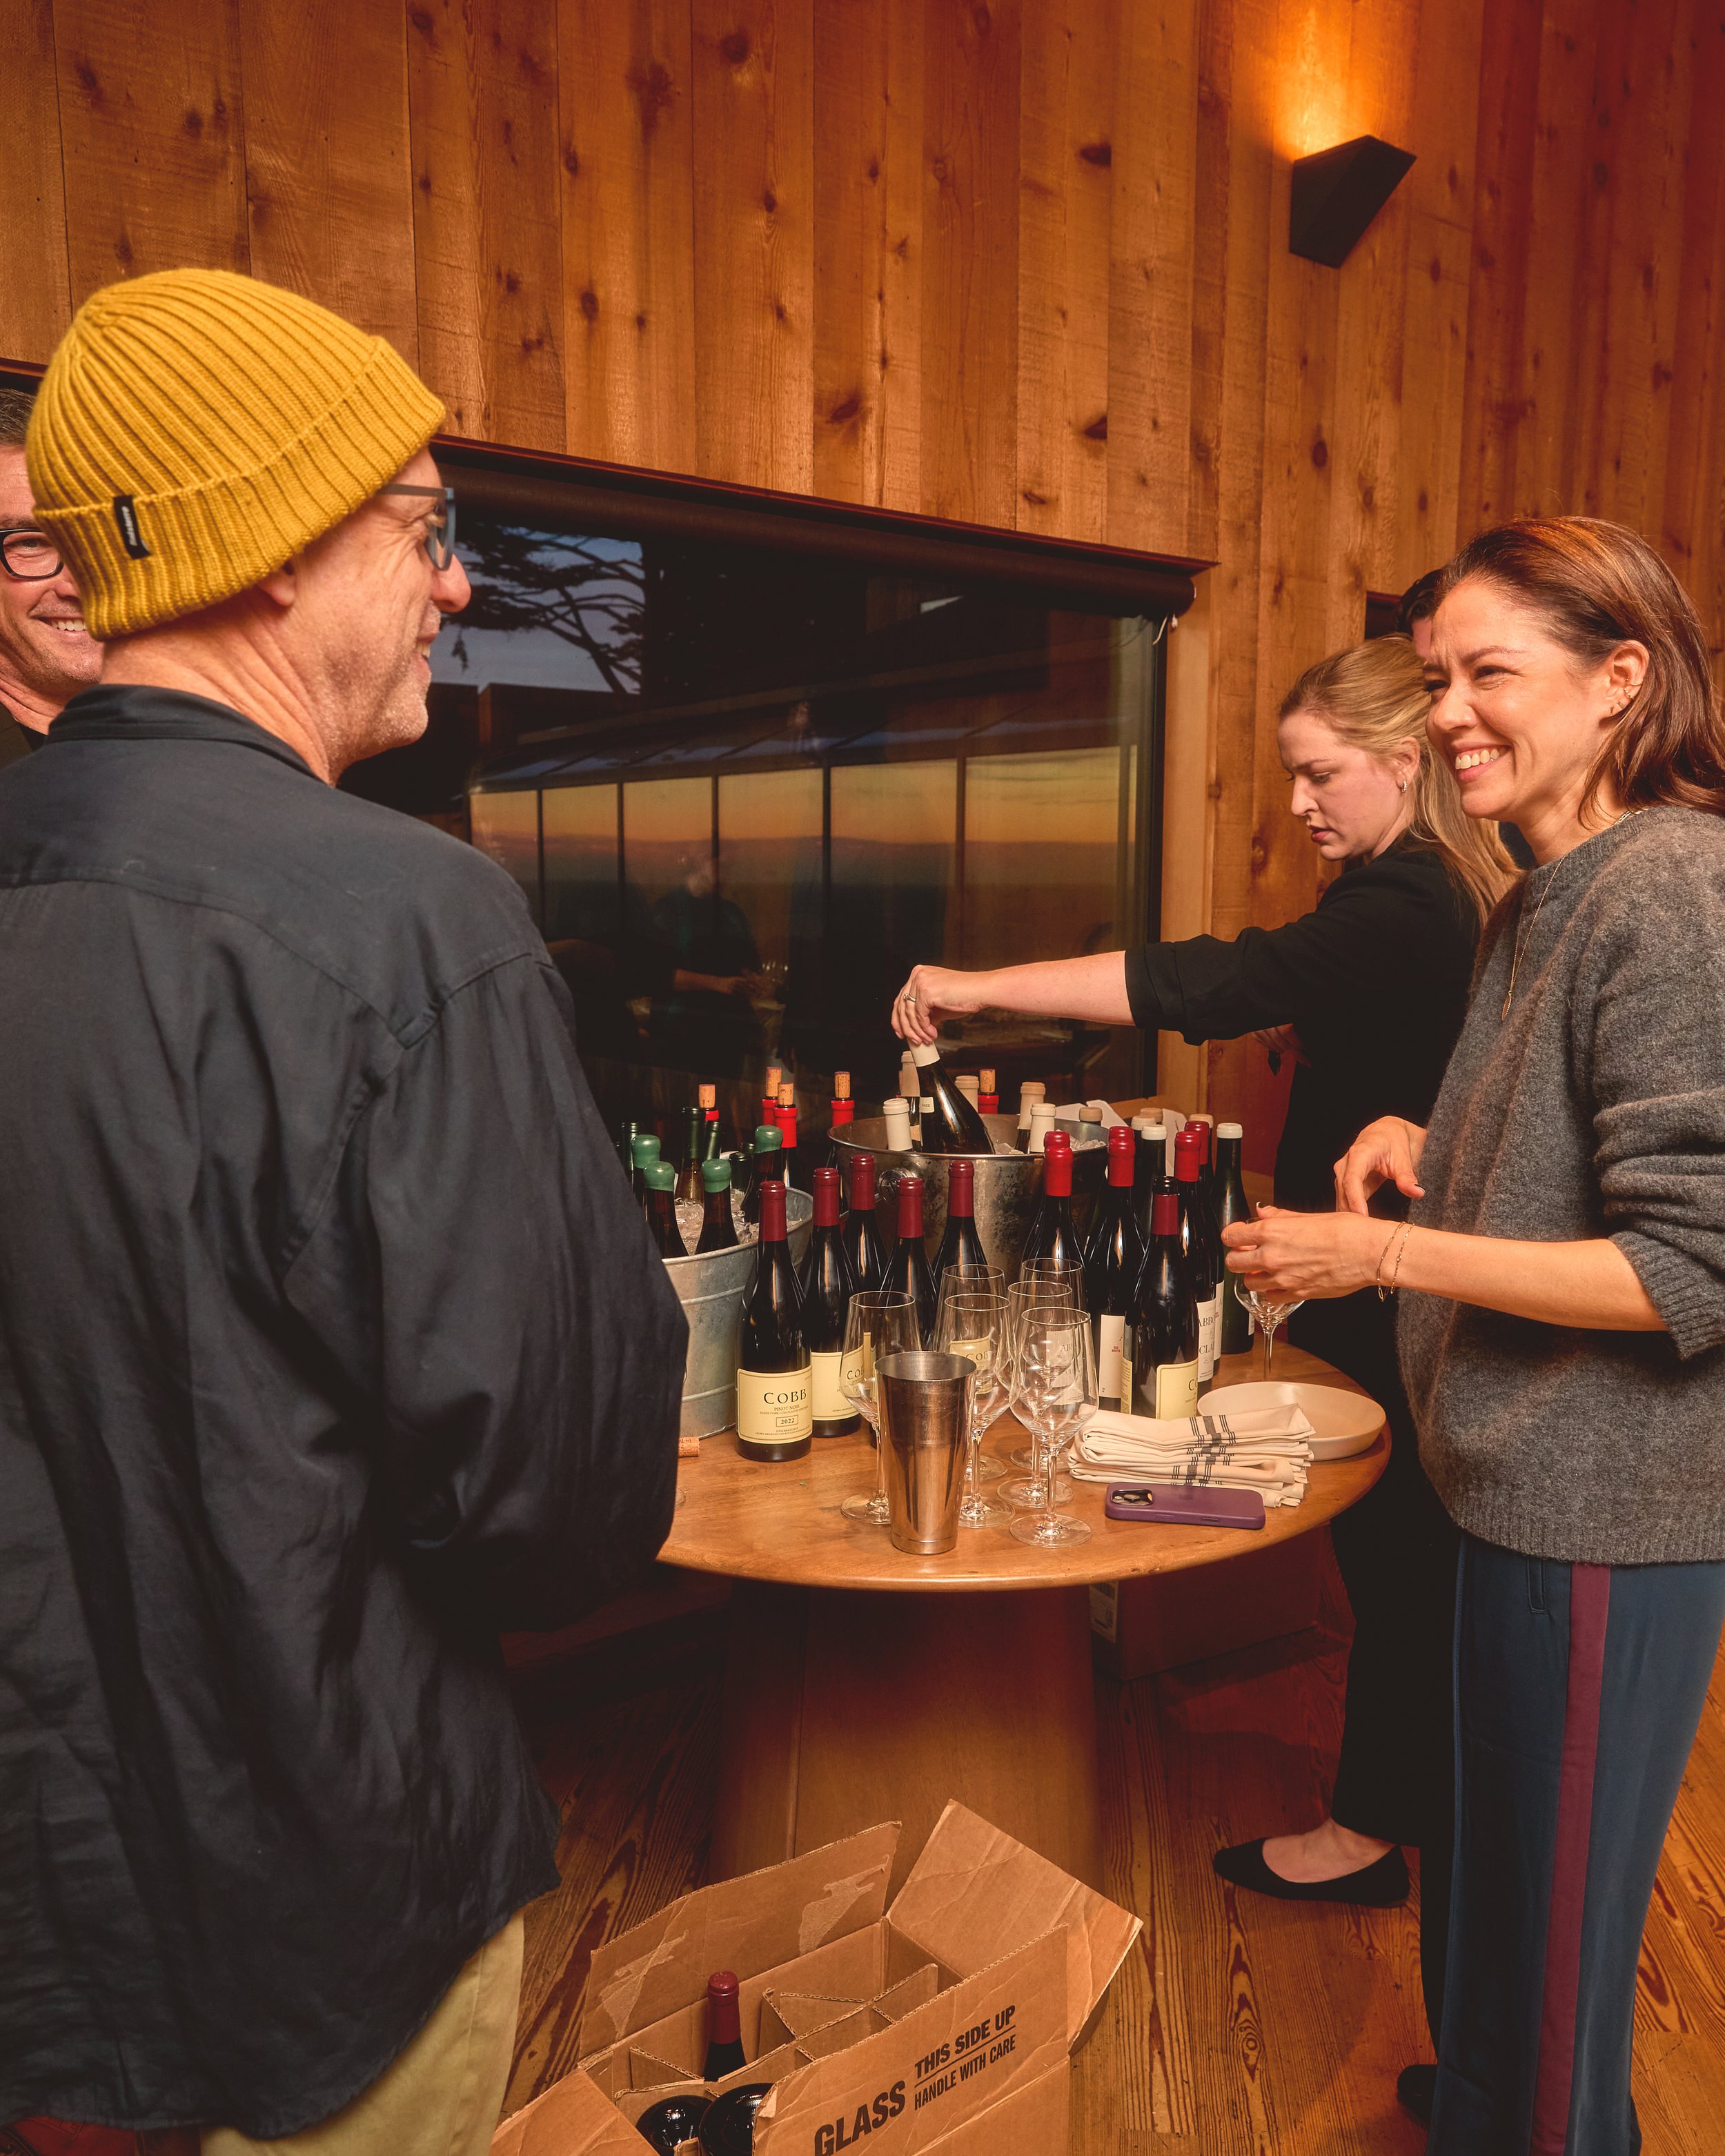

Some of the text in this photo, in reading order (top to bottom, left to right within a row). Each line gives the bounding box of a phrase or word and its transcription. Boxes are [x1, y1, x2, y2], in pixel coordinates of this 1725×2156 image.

[764, 1388, 807, 1405] COBB
[914, 2005, 1016, 2079] THIS SIDE UP
[914, 2034, 1016, 2110] HANDLE WITH CARE
[814, 2080, 906, 2156] GLASS
